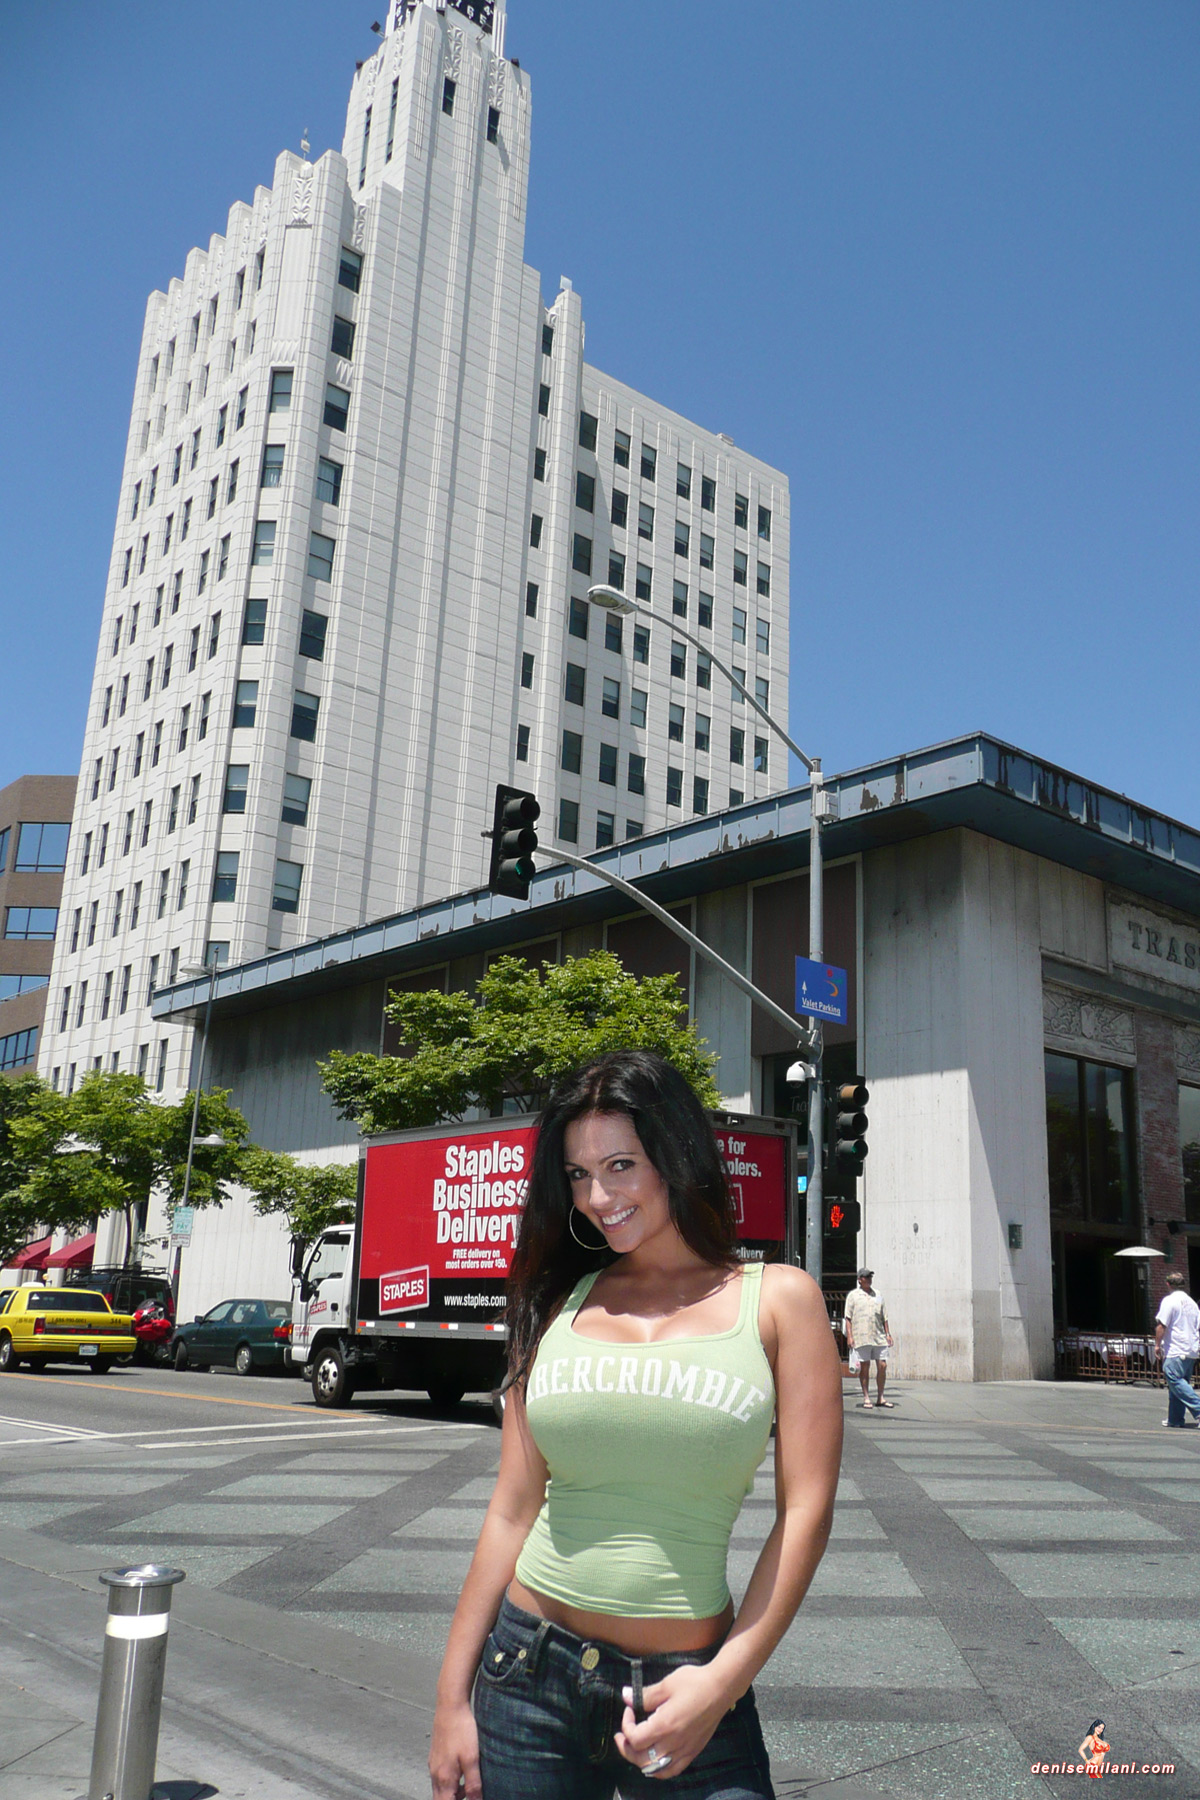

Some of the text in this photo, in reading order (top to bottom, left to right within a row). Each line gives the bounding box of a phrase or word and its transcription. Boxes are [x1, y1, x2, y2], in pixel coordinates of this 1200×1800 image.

[1128, 920, 1200, 972] TRAS
[818, 1002, 841, 1015] Parking
[728, 1136, 746, 1155] for
[445, 1141, 525, 1182] Staples
[433, 1176, 529, 1211] Business
[453, 1248, 500, 1260] FREE delivery on
[445, 1260, 460, 1269] most
[461, 1259, 479, 1269] orders
[481, 1260, 494, 1268] over
[383, 1279, 425, 1301] STAPLES
[444, 1293, 507, 1309] www.staples.com
